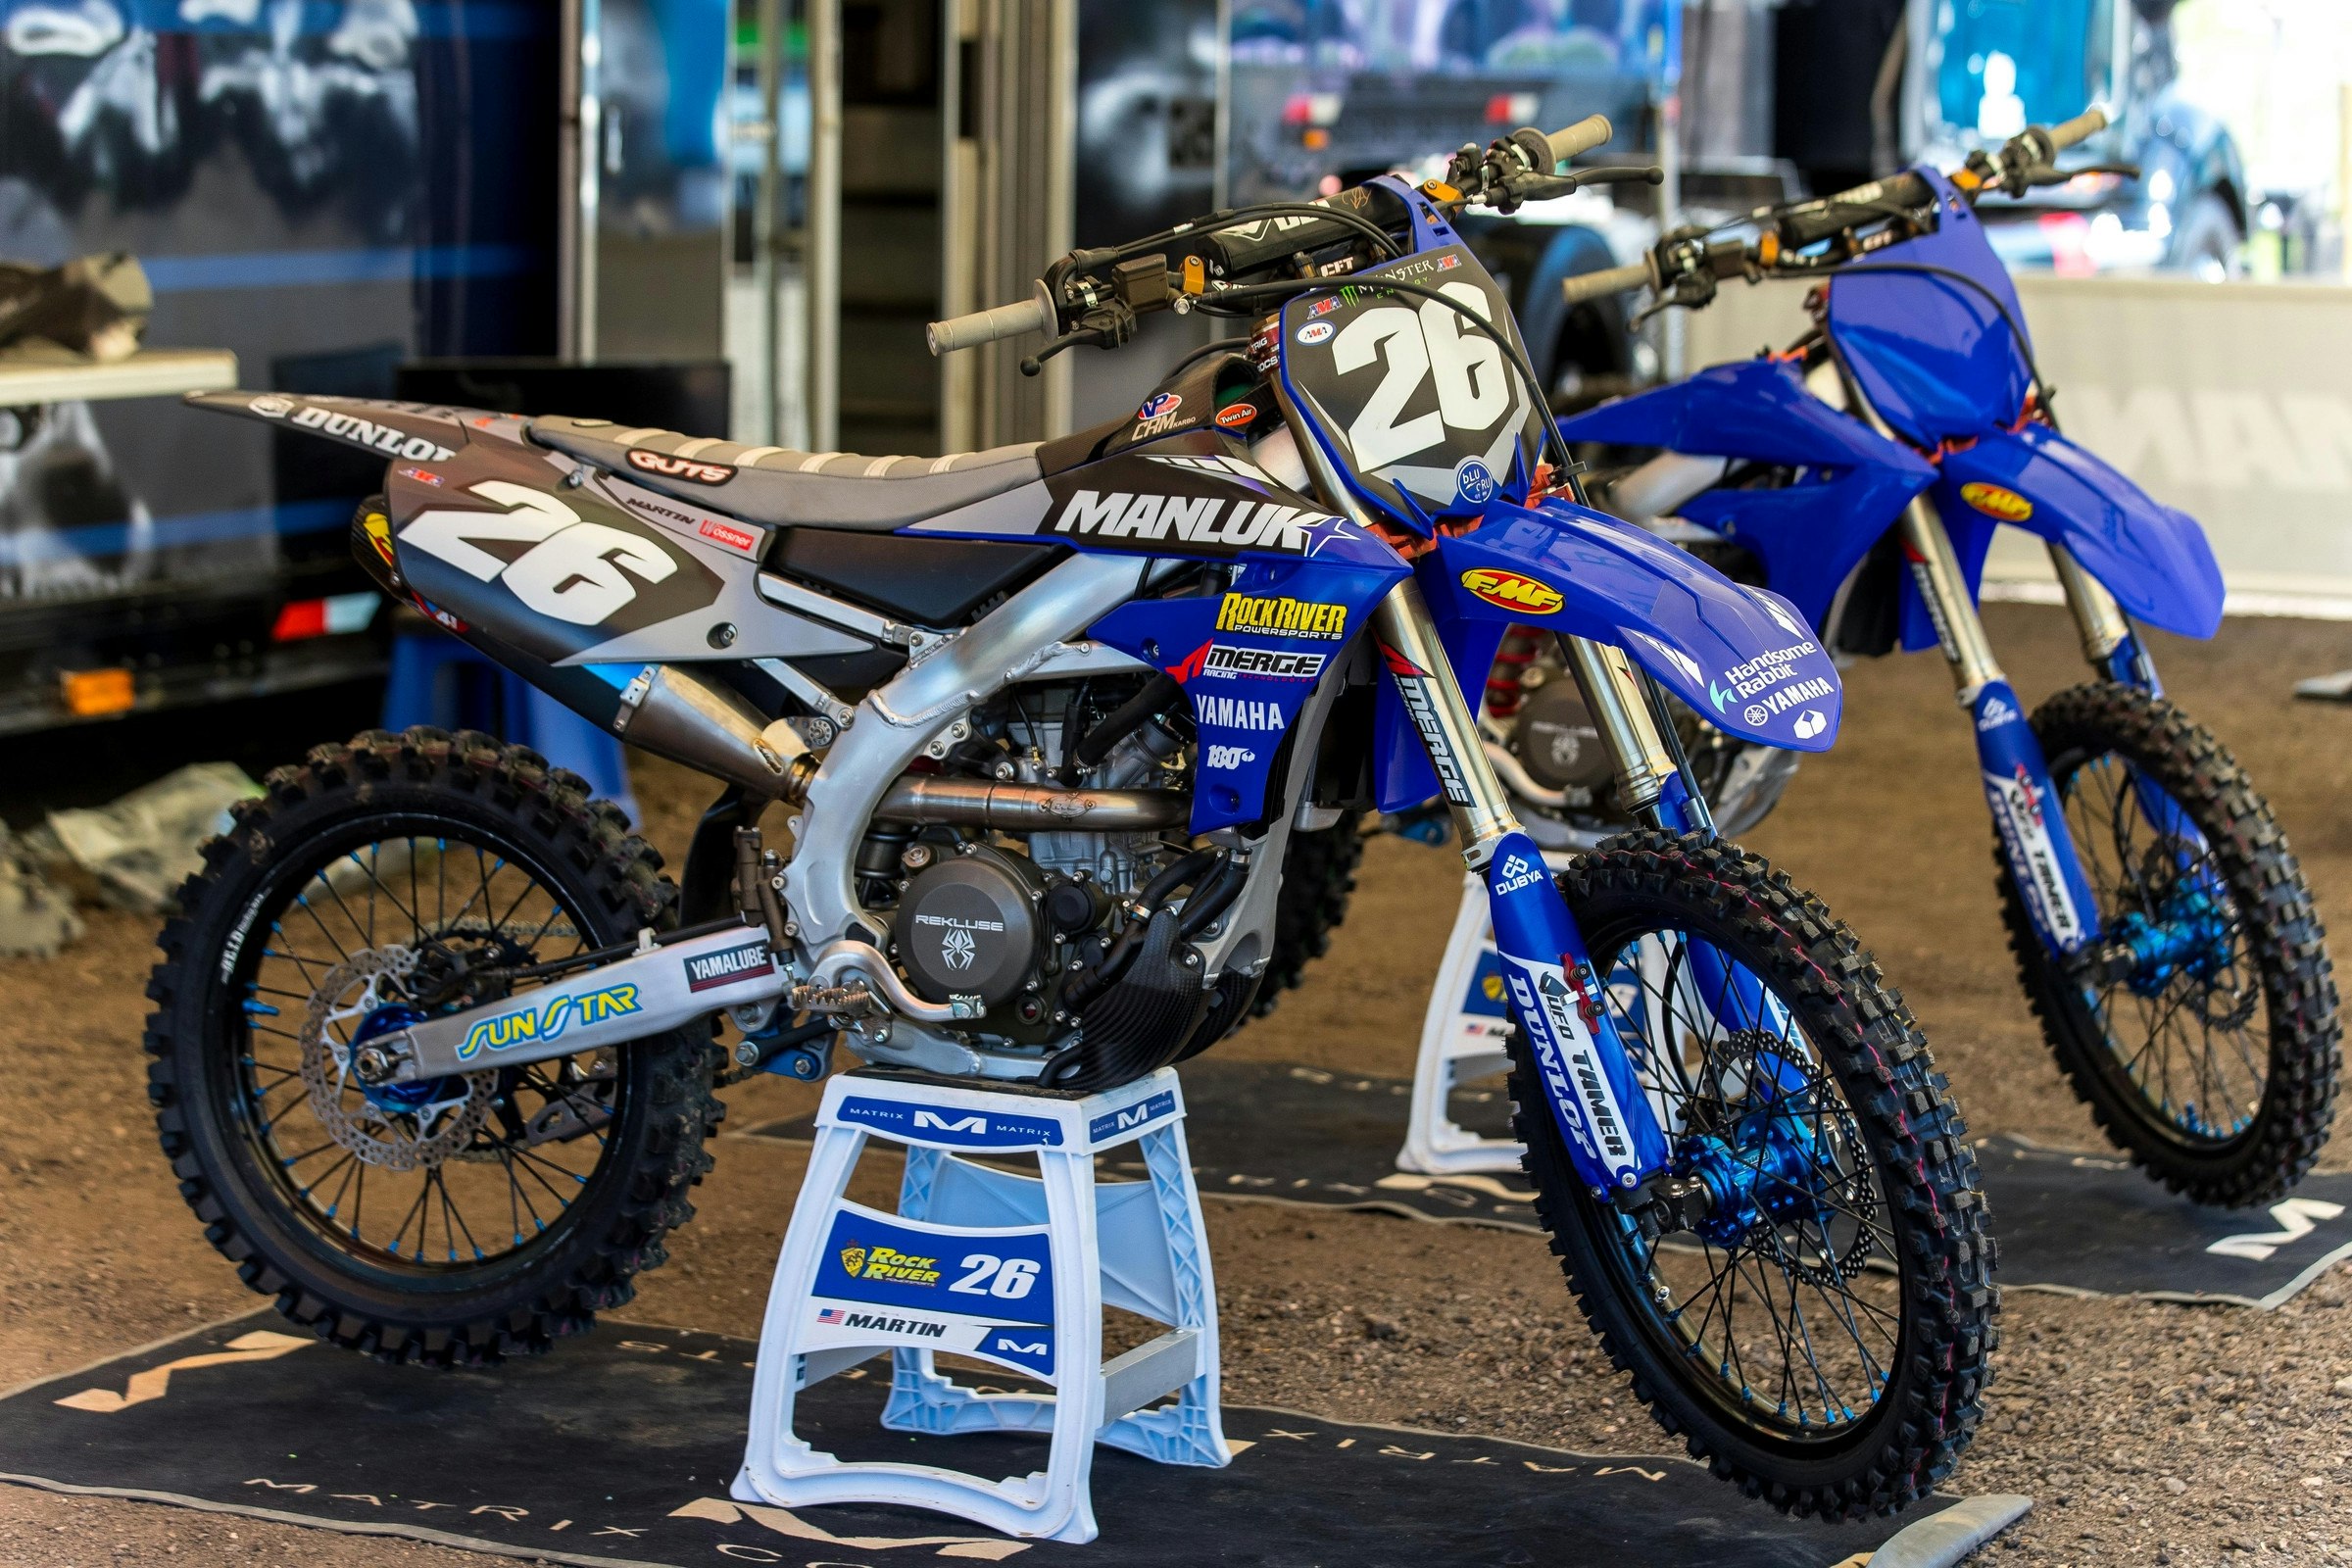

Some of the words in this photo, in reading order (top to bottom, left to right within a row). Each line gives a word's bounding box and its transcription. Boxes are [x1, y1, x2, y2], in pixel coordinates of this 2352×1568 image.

[1306, 295, 1344, 319] AMA
[1304, 326, 1328, 339] AMA
[1332, 281, 1509, 472] 26
[1142, 393, 1169, 417] VP
[1220, 412, 1240, 424] Twin
[1241, 408, 1252, 418] Air
[1131, 412, 1178, 441] CRM
[629, 450, 732, 482] GUTS
[626, 497, 696, 524] MARTIN
[1054, 489, 1315, 550] MANLUK
[397, 480, 678, 625] 26
[1462, 571, 1564, 608] FMF
[1274, 597, 1348, 633] RIVER
[1234, 624, 1343, 640] POWERSPORTS
[1202, 668, 1238, 680] RACING
[1206, 647, 1323, 676] MERGE
[1724, 641, 1817, 686] Handsome
[1735, 662, 1798, 700] Rabbit
[1761, 676, 1836, 715] YAMAHA
[1196, 694, 1286, 731] YAMAHA
[1399, 676, 1468, 803] MERGE
[1494, 869, 1544, 896] DUBYA
[914, 914, 1004, 932] REKLUSE
[690, 945, 767, 980] YAMALUBE
[1545, 995, 1576, 1041] UFO
[1508, 973, 1596, 1159] DUNLOP
[1572, 1049, 1628, 1157] TAMER
[850, 1107, 904, 1120] MATRIX
[996, 1125, 1052, 1137] MATRIX
[1093, 1121, 1115, 1134] MATRIX
[861, 1262, 941, 1283] RIVER
[867, 1246, 938, 1269] ROCK
[948, 1253, 1042, 1299] 26
[845, 1313, 948, 1338] MARTIN
[243, 1477, 651, 1539] MATRIX
